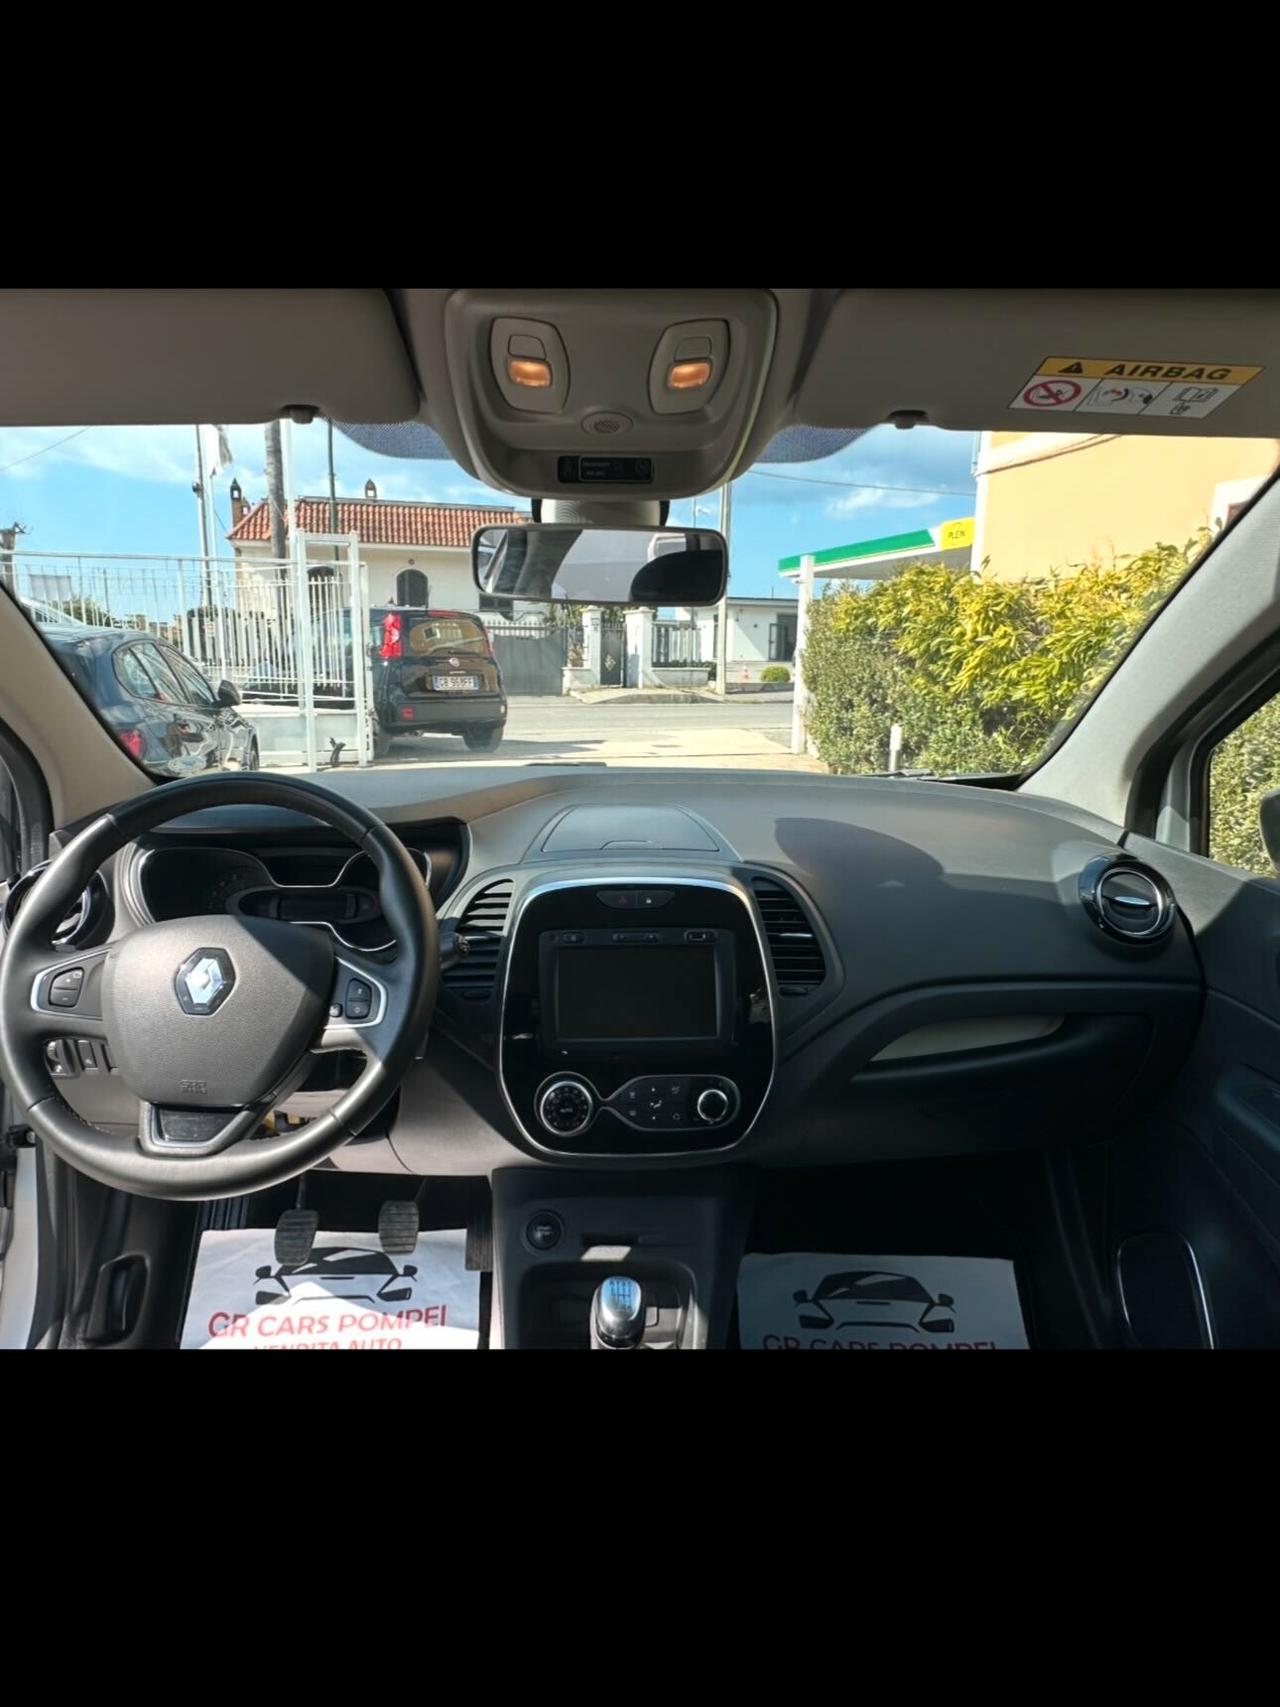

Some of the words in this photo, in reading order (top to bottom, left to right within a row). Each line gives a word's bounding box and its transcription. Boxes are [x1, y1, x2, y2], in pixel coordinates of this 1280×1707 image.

[1104, 363, 1232, 381] AIRBAG
[208, 1311, 249, 1337] GR
[257, 1314, 329, 1337] CARS
[338, 1304, 447, 1333] POMPEI
